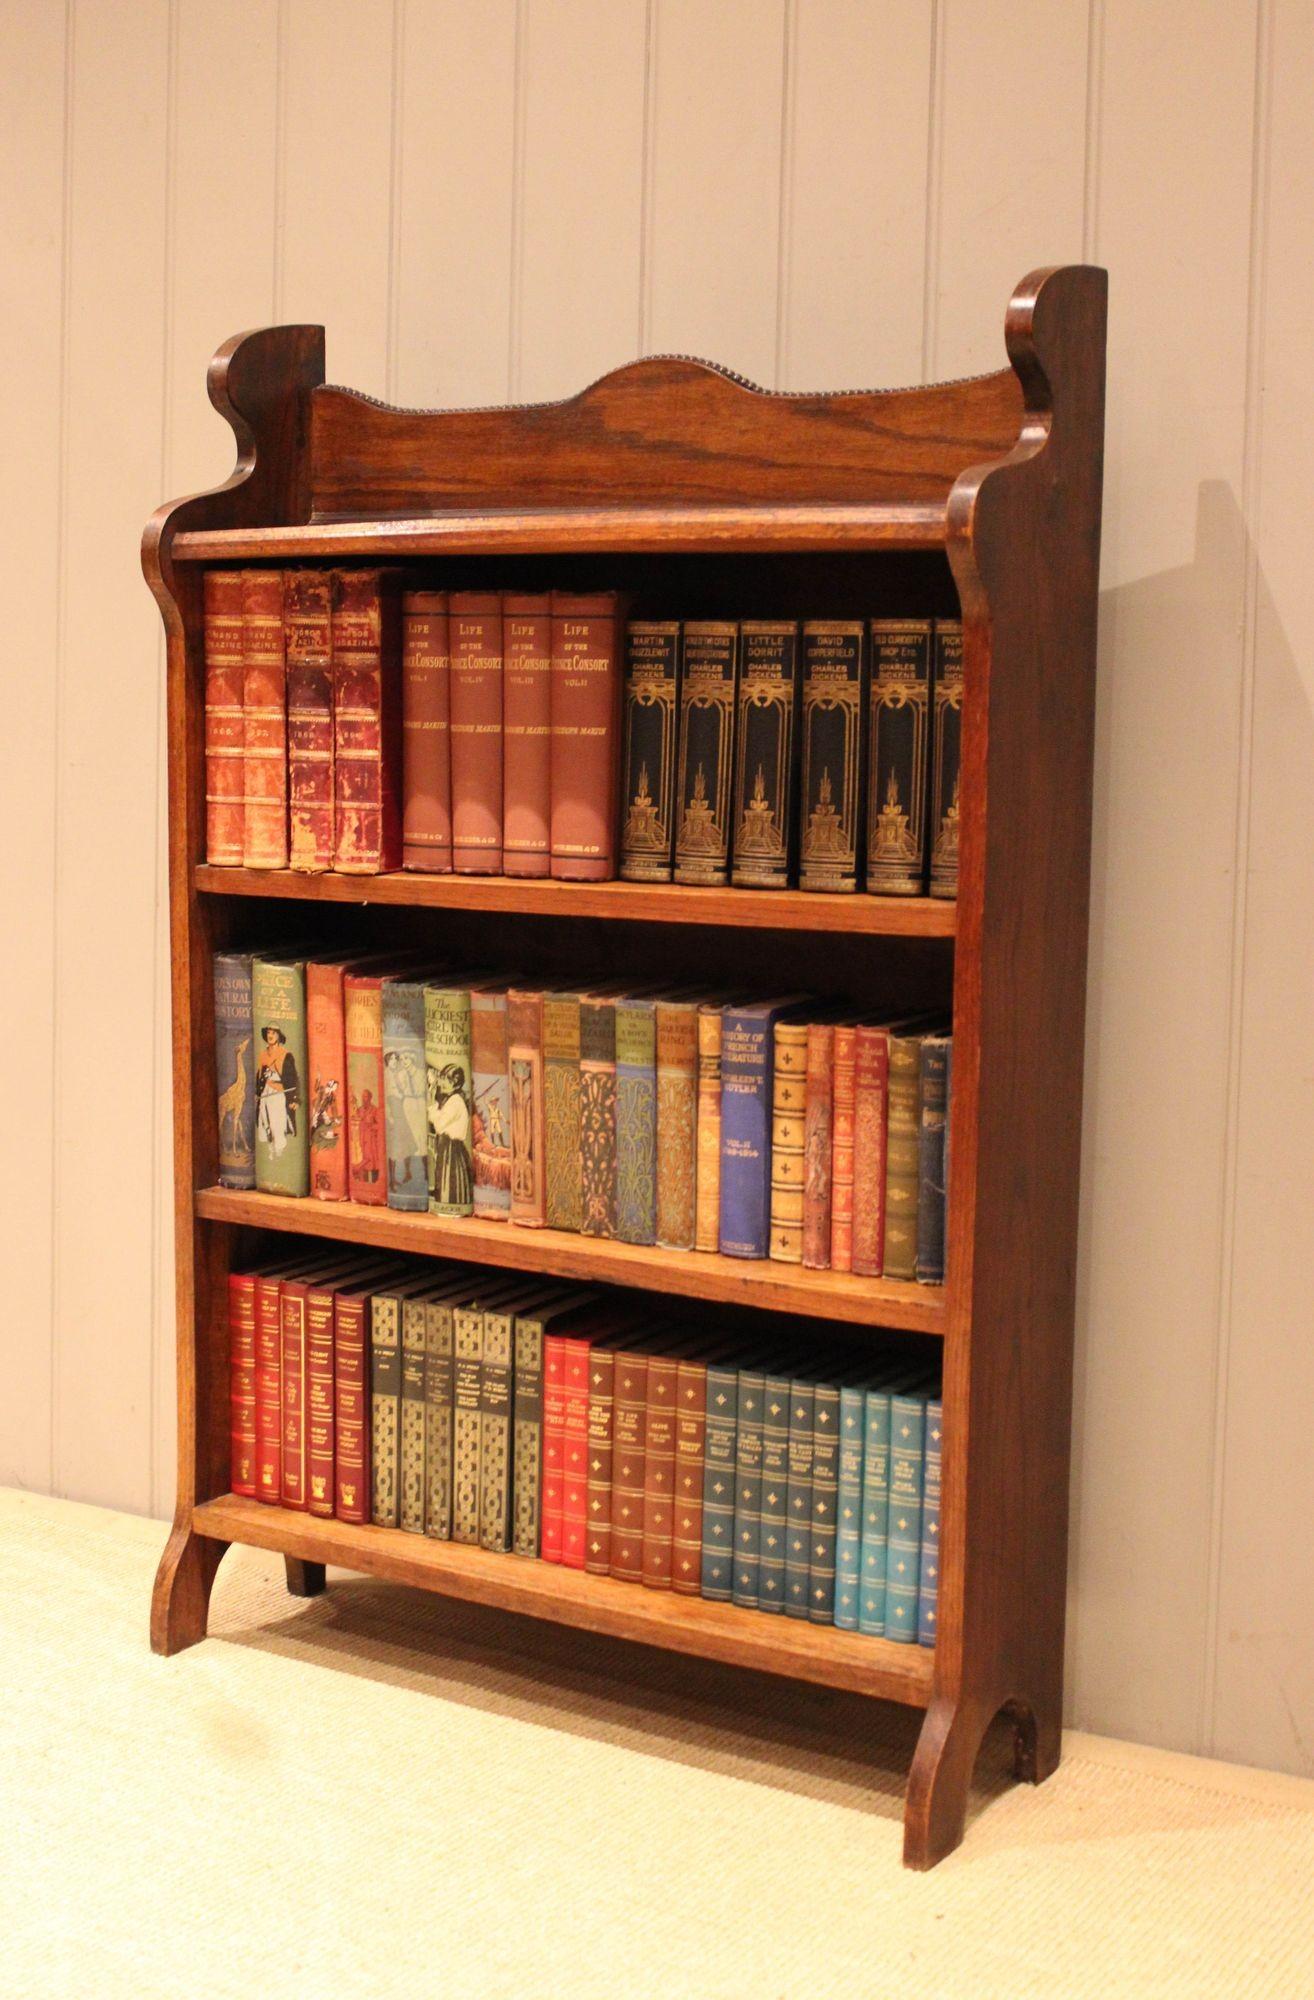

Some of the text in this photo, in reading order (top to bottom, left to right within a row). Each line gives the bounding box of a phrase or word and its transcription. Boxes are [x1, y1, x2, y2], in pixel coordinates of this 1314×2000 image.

[408, 624, 430, 634] LIFE
[460, 624, 483, 635] LIFE
[511, 624, 535, 635] LIFE
[564, 624, 589, 635] LIFE
[748, 636, 784, 646] LITTLE
[817, 636, 845, 646] DAVID
[748, 647, 784, 657] DORRIT
[416, 652, 448, 668] CONSORT
[468, 654, 502, 670] CONSORT
[573, 655, 609, 671] CONSORT
[747, 663, 782, 671] CHARLES
[811, 664, 848, 673] CHARLES
[879, 663, 916, 672] CHARLES
[811, 672, 848, 681] DICKENS
[435, 998, 451, 1009] The
[217, 1005, 251, 1018] STORY
[426, 1007, 470, 1022] LUCKIEST
[427, 1019, 466, 1035] GIRL IN
[736, 1023, 743, 1032] A
[438, 1032, 470, 1046] SCHOOL
[722, 1031, 765, 1043] STORY OF
[723, 1052, 766, 1064] ERATURE
